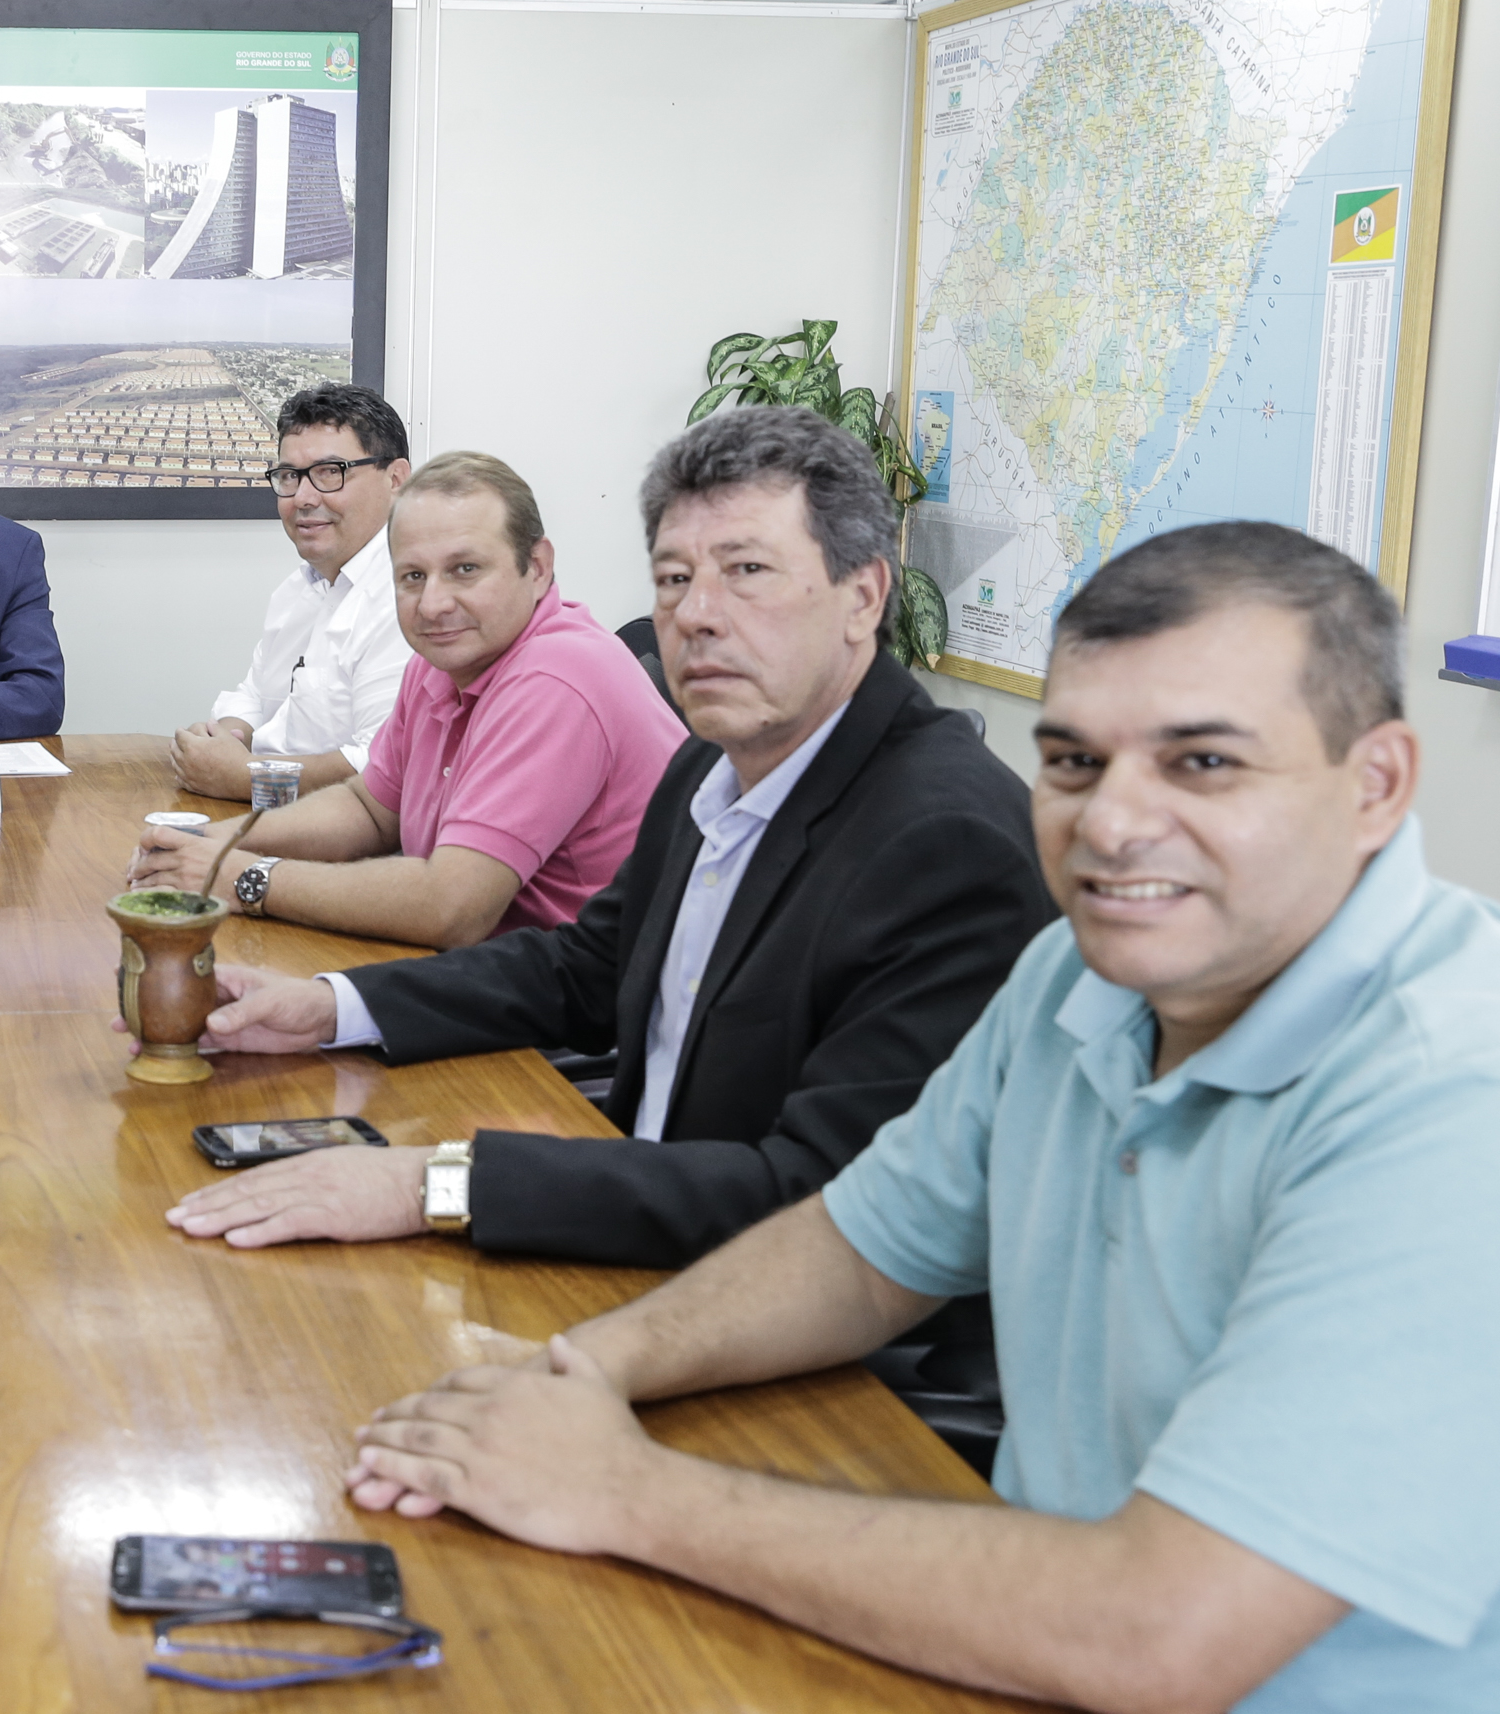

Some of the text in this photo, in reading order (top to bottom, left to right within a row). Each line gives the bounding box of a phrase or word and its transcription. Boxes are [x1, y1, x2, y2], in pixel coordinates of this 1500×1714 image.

[272, 51, 283, 59] DO
[1194, 0, 1272, 98] SANTA CATARINA
[1209, 273, 1282, 439] ATLÂNTICO
[984, 424, 1032, 499] URUGUAI
[1148, 451, 1201, 535] OCEANO
